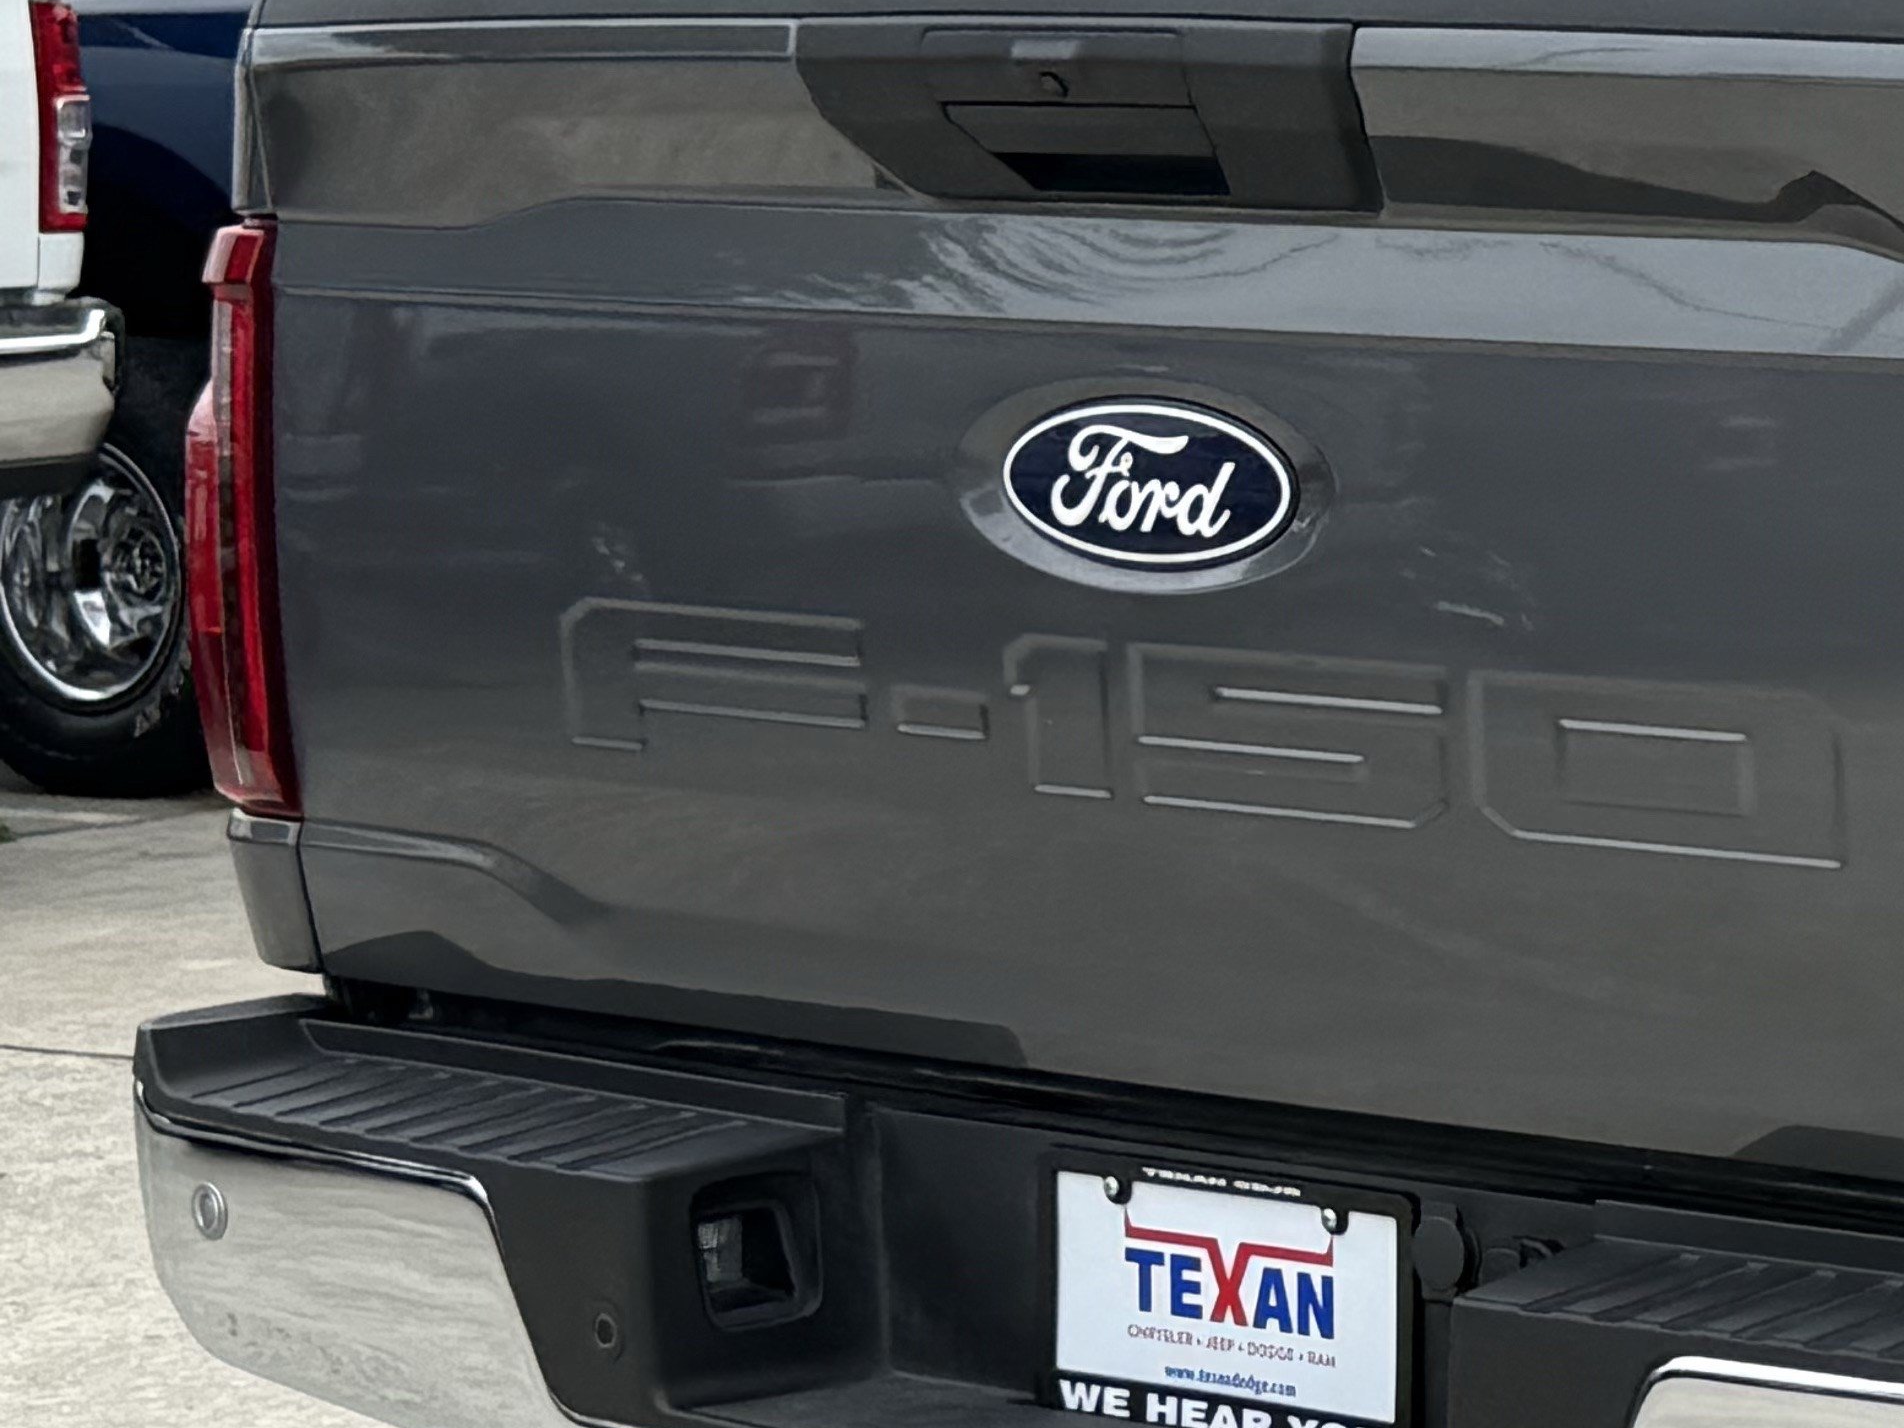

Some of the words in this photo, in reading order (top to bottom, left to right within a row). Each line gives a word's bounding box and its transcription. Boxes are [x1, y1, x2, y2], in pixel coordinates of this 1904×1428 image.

[1050, 424, 1235, 538] Ford
[560, 598, 1843, 869] F-150
[1124, 1224, 1334, 1339] TEXAN
[1058, 1379, 1130, 1418] WE
[1308, 1351, 1336, 1368] RAM
